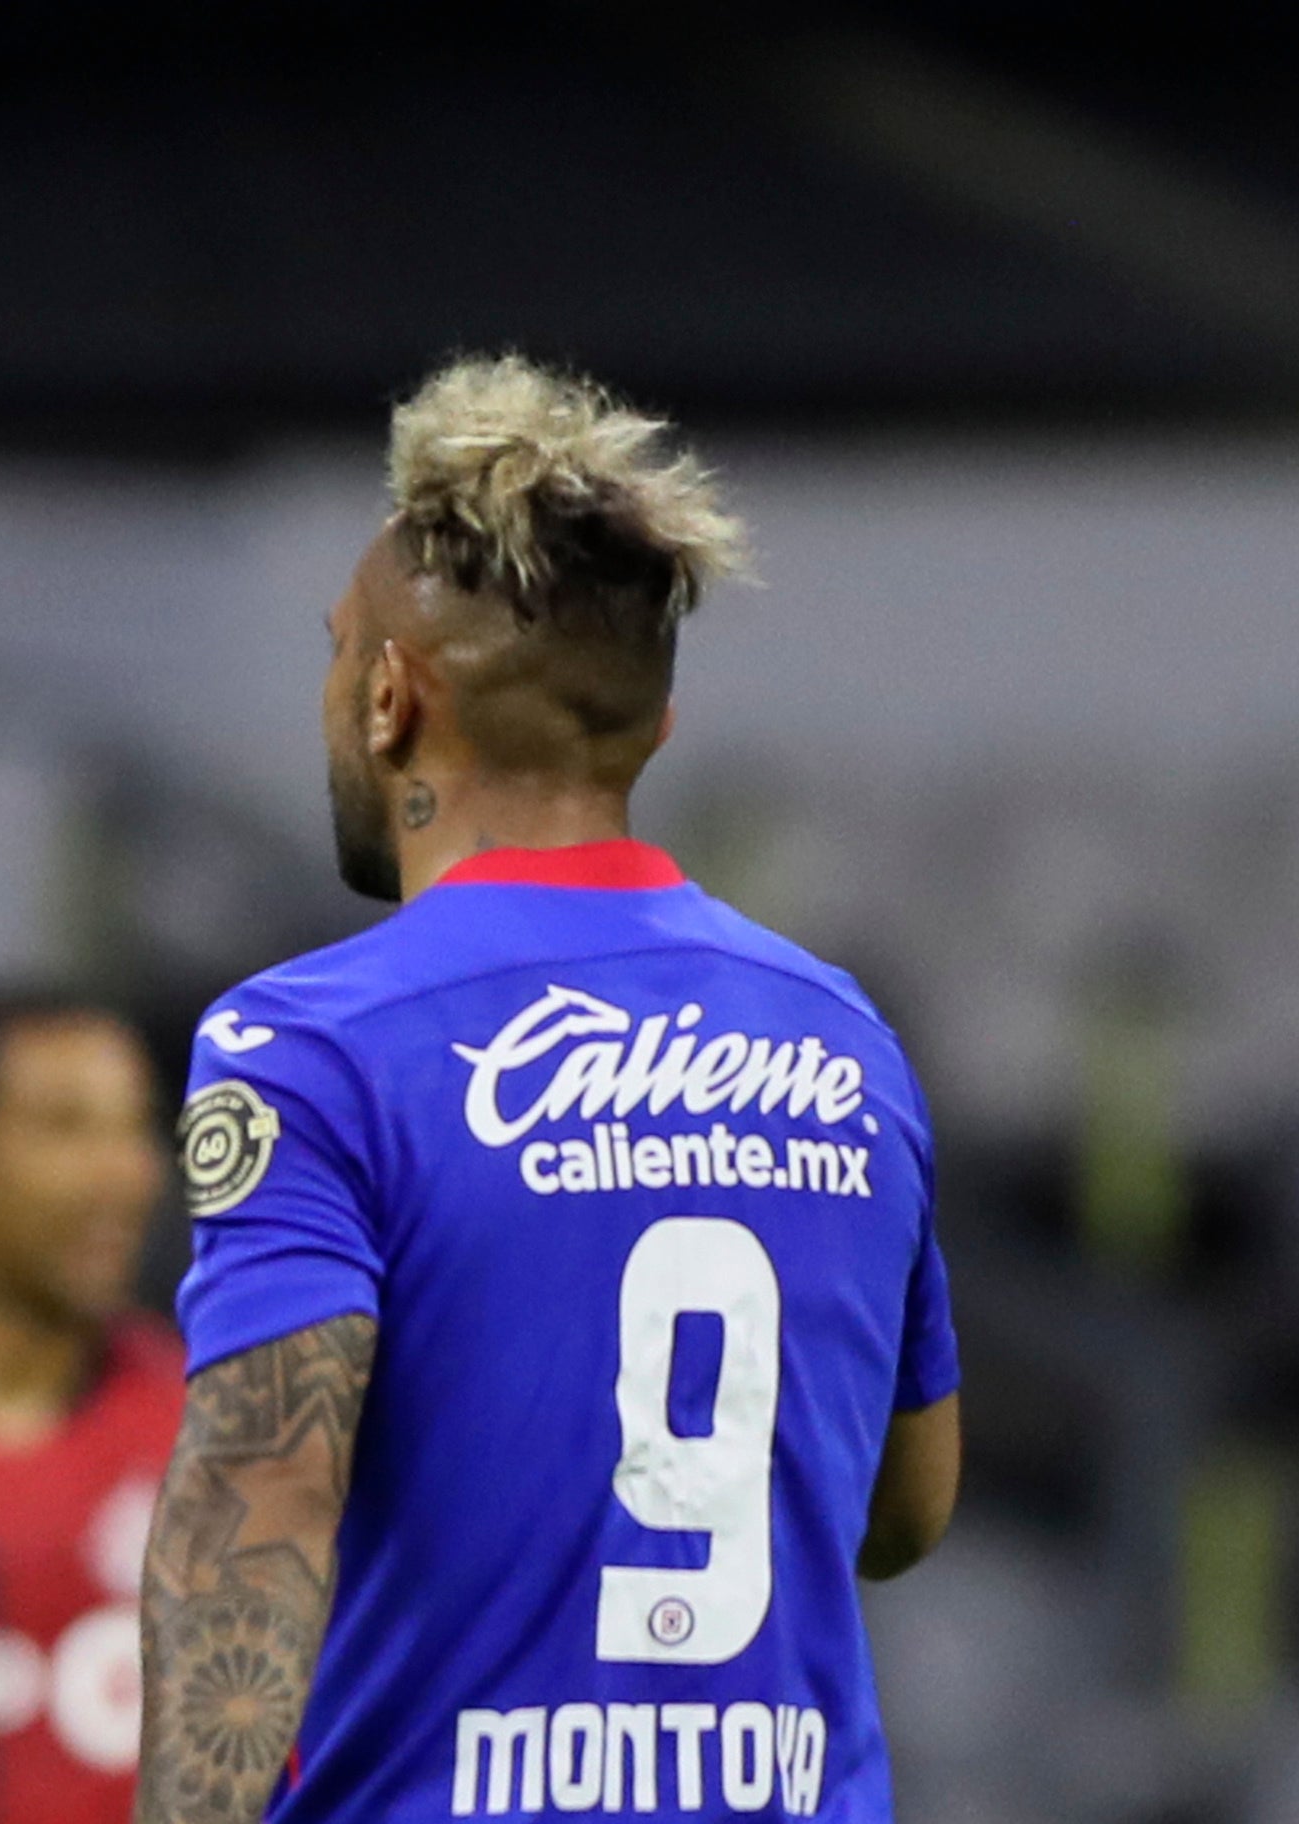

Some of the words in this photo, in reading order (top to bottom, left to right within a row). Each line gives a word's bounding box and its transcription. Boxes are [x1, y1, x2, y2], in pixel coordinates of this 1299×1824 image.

[519, 1122, 872, 1198] caliente.mx
[596, 1216, 782, 1665] 9
[452, 1701, 827, 1817] MONTOYA
